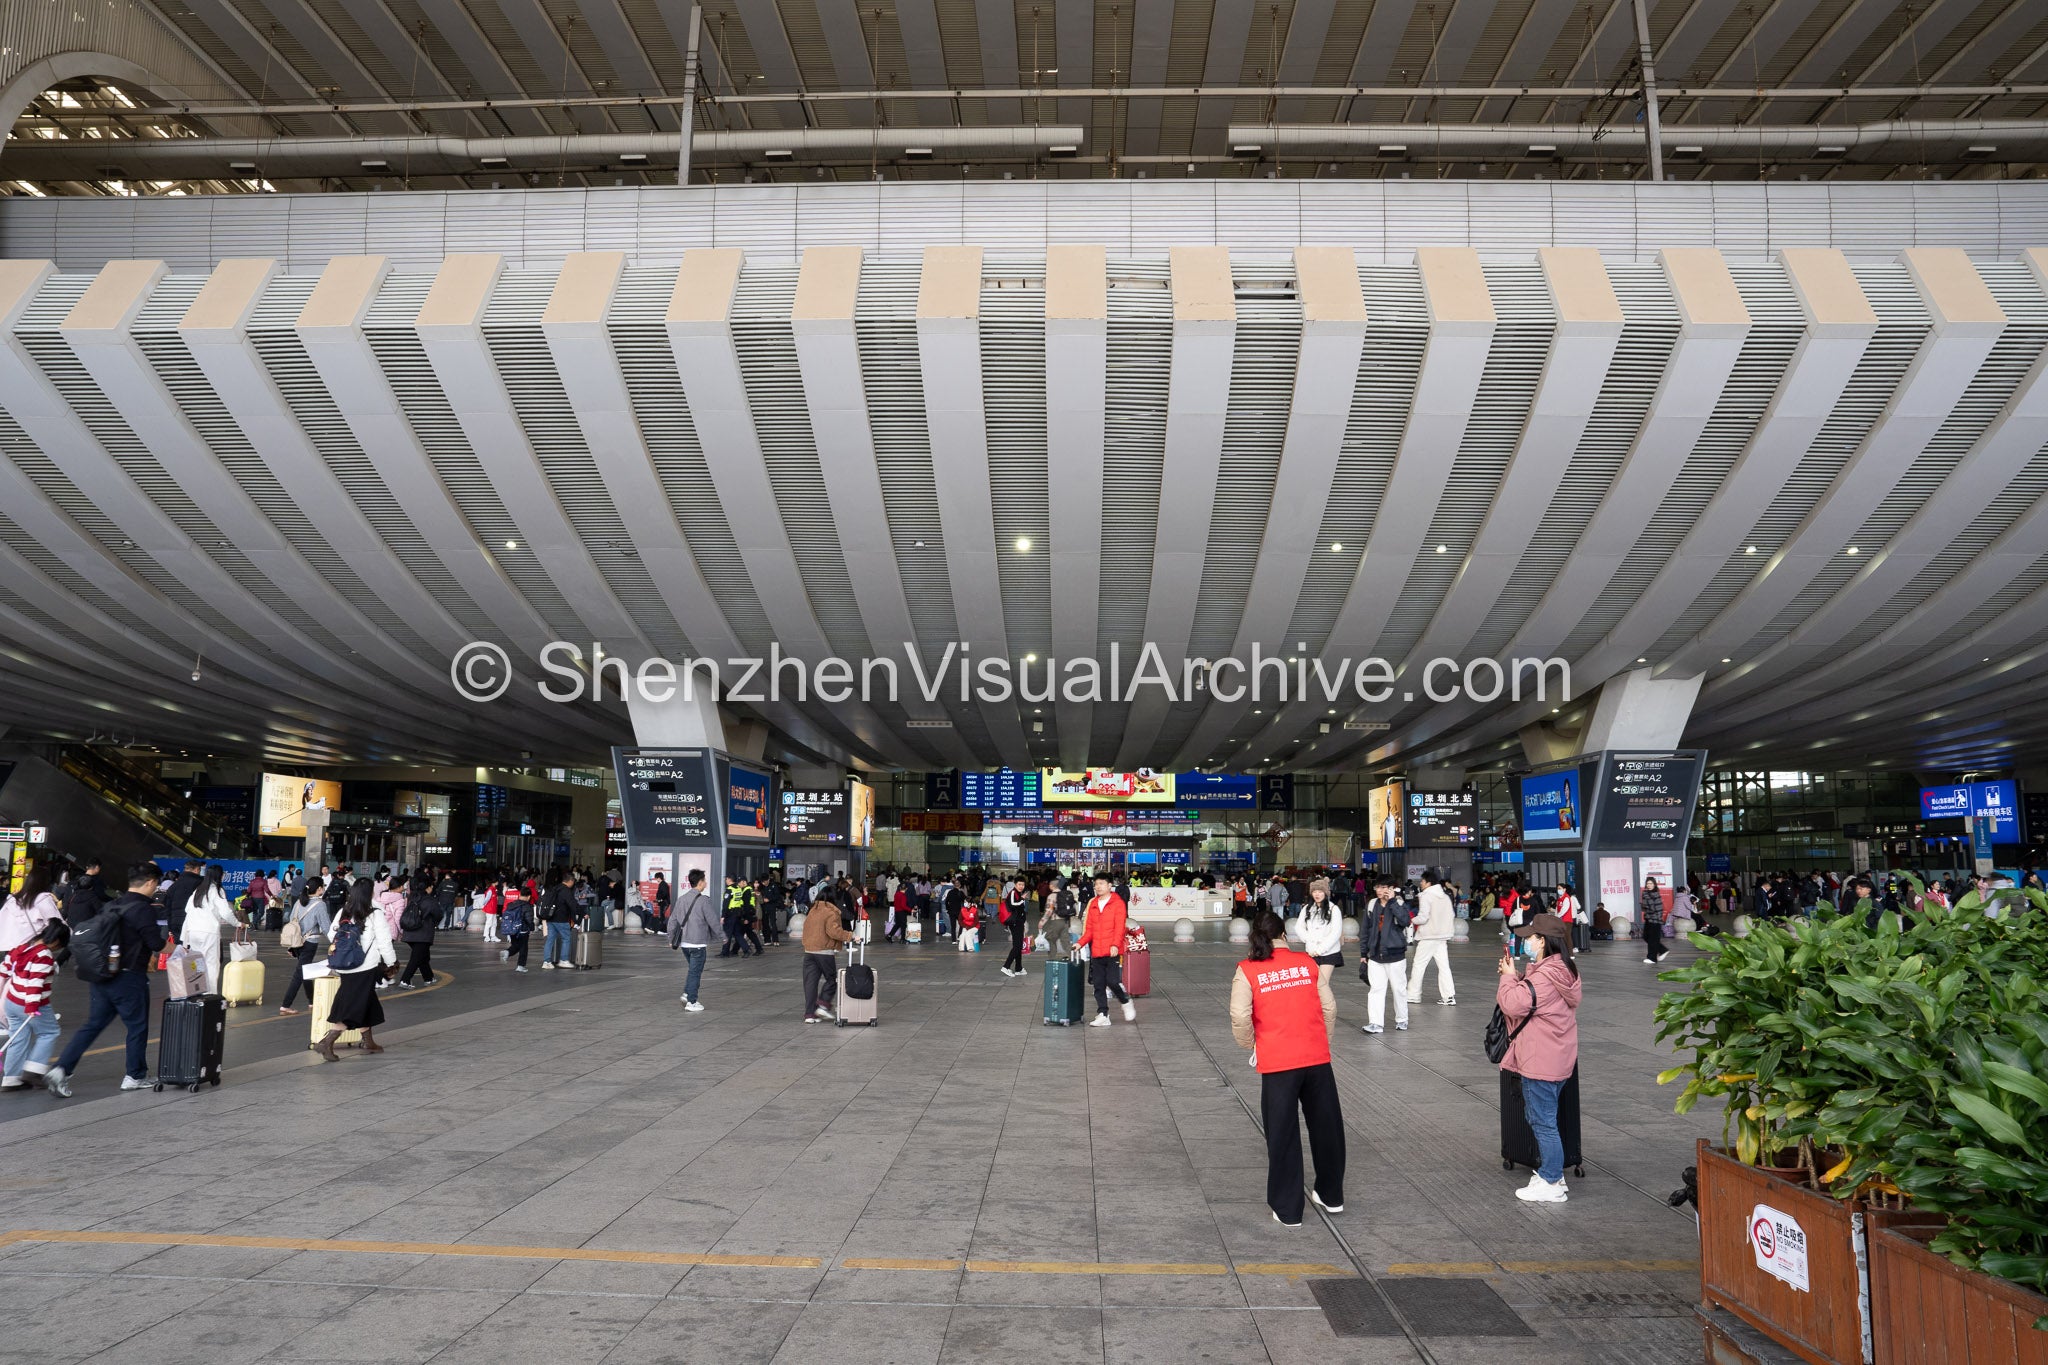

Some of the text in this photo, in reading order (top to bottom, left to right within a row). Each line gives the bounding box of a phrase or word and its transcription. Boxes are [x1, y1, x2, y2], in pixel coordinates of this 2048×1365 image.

[796, 793, 843, 802] 深圳北站
[937, 791, 950, 801] A
[1270, 792, 1283, 802] A
[1425, 794, 1472, 803] 深圳北站
[1257, 966, 1310, 986] 民治志愿者
[1282, 979, 1312, 989] VOLUNTEER
[1776, 1222, 1804, 1245] 禁止吸烟
[1784, 1238, 1805, 1254] SMOKING
